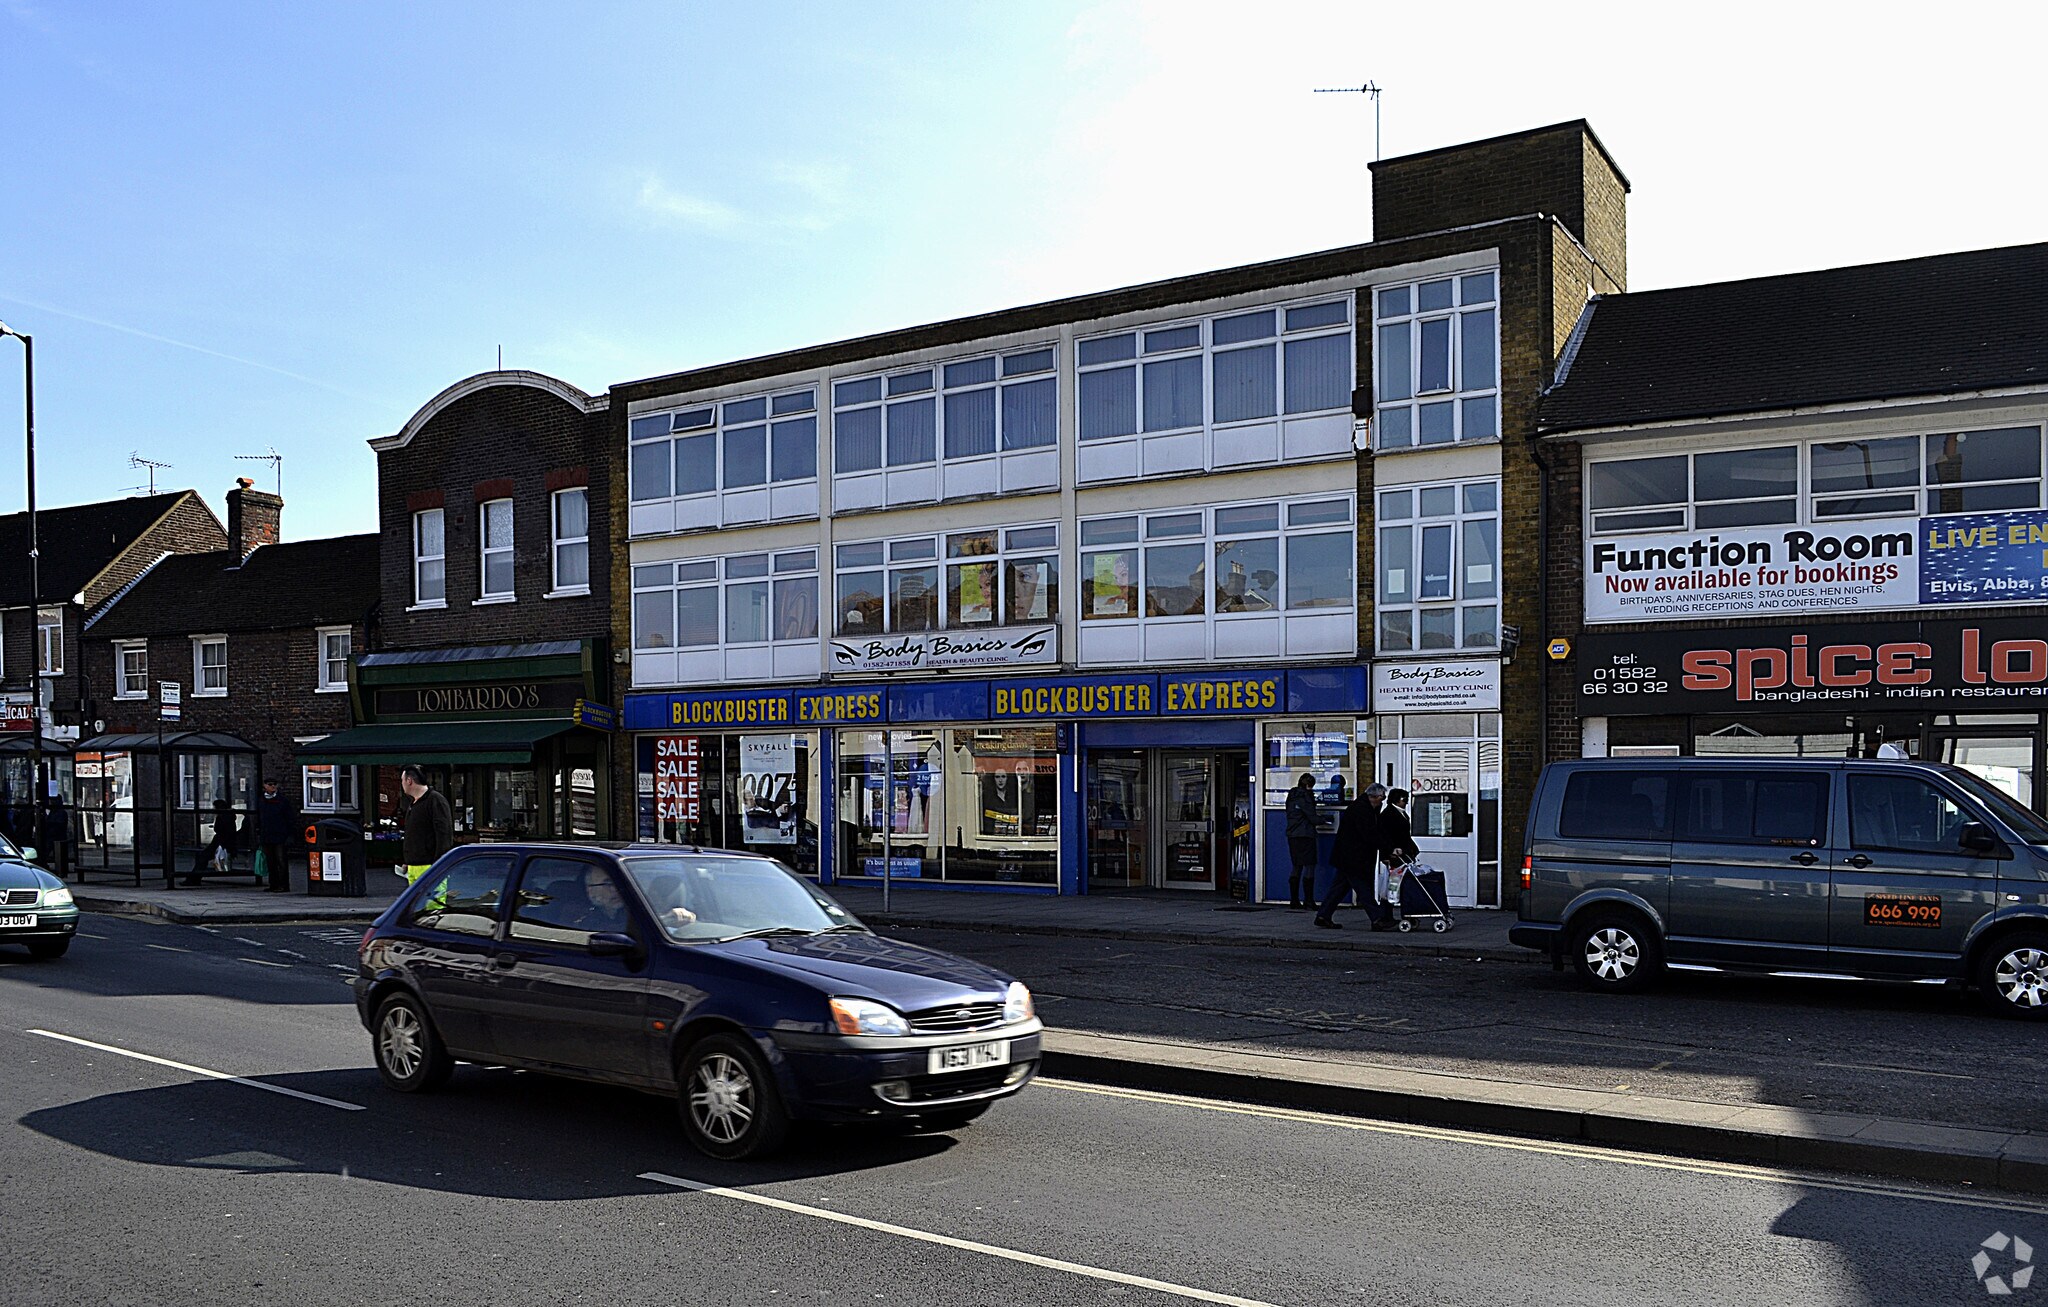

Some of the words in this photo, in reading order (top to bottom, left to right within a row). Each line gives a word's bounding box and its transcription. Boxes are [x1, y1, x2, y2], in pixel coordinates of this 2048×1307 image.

[1929, 526, 1998, 549] LIVE
[1592, 535, 1771, 573] Function
[1783, 530, 1913, 563] Room
[1605, 573, 1649, 594] Now
[1654, 567, 1751, 591] available
[1757, 564, 1789, 585] for
[1794, 562, 1899, 585] bookings
[1930, 579, 1978, 594] Elvis,
[1983, 577, 2035, 591] Abba,
[1619, 594, 1674, 606] BIRTHDAYS,
[1676, 590, 1756, 604] ANNIVERSARIES,
[1759, 589, 1785, 598] STAG
[1787, 588, 1817, 599] DUES,
[1820, 586, 1842, 595] HEN
[1844, 585, 1886, 596] NIGHTS,
[1644, 603, 1689, 614] WEDDING
[1692, 600, 1753, 612] RECEPTIONS
[1758, 600, 1780, 609] AND
[1781, 597, 1858, 608] CONFERENCES
[863, 636, 927, 666] Body
[929, 636, 1008, 657] Basics
[1612, 653, 1638, 665] tel:
[863, 660, 911, 669] 01582-471858
[1593, 667, 1657, 680] 01582
[1681, 634, 1932, 702] spice
[1961, 628, 2048, 684] lo
[1387, 667, 1430, 684] Body
[1430, 667, 1485, 679] Basics
[996, 684, 1151, 714] BLOCKBUSTER
[1167, 680, 1276, 710] EXPRESS
[1582, 683, 1608, 695] 66
[1612, 682, 1638, 694] 30
[1643, 681, 1668, 693] 32
[1754, 685, 1870, 704] bangladeshi
[1886, 686, 1945, 698] indian
[417, 685, 540, 712] LOMBARDO'S
[582, 706, 612, 718] BLOCKBUSTER
[672, 698, 788, 724] BLOCKBUSTER
[799, 694, 880, 720] EXPRESS
[657, 739, 698, 757] SALE
[748, 743, 788, 752] SKYFALL
[657, 760, 698, 777] SALE
[657, 781, 698, 799] SALE
[657, 802, 698, 820] SALE
[1869, 904, 1903, 919] 666
[1907, 905, 1941, 920] 999
